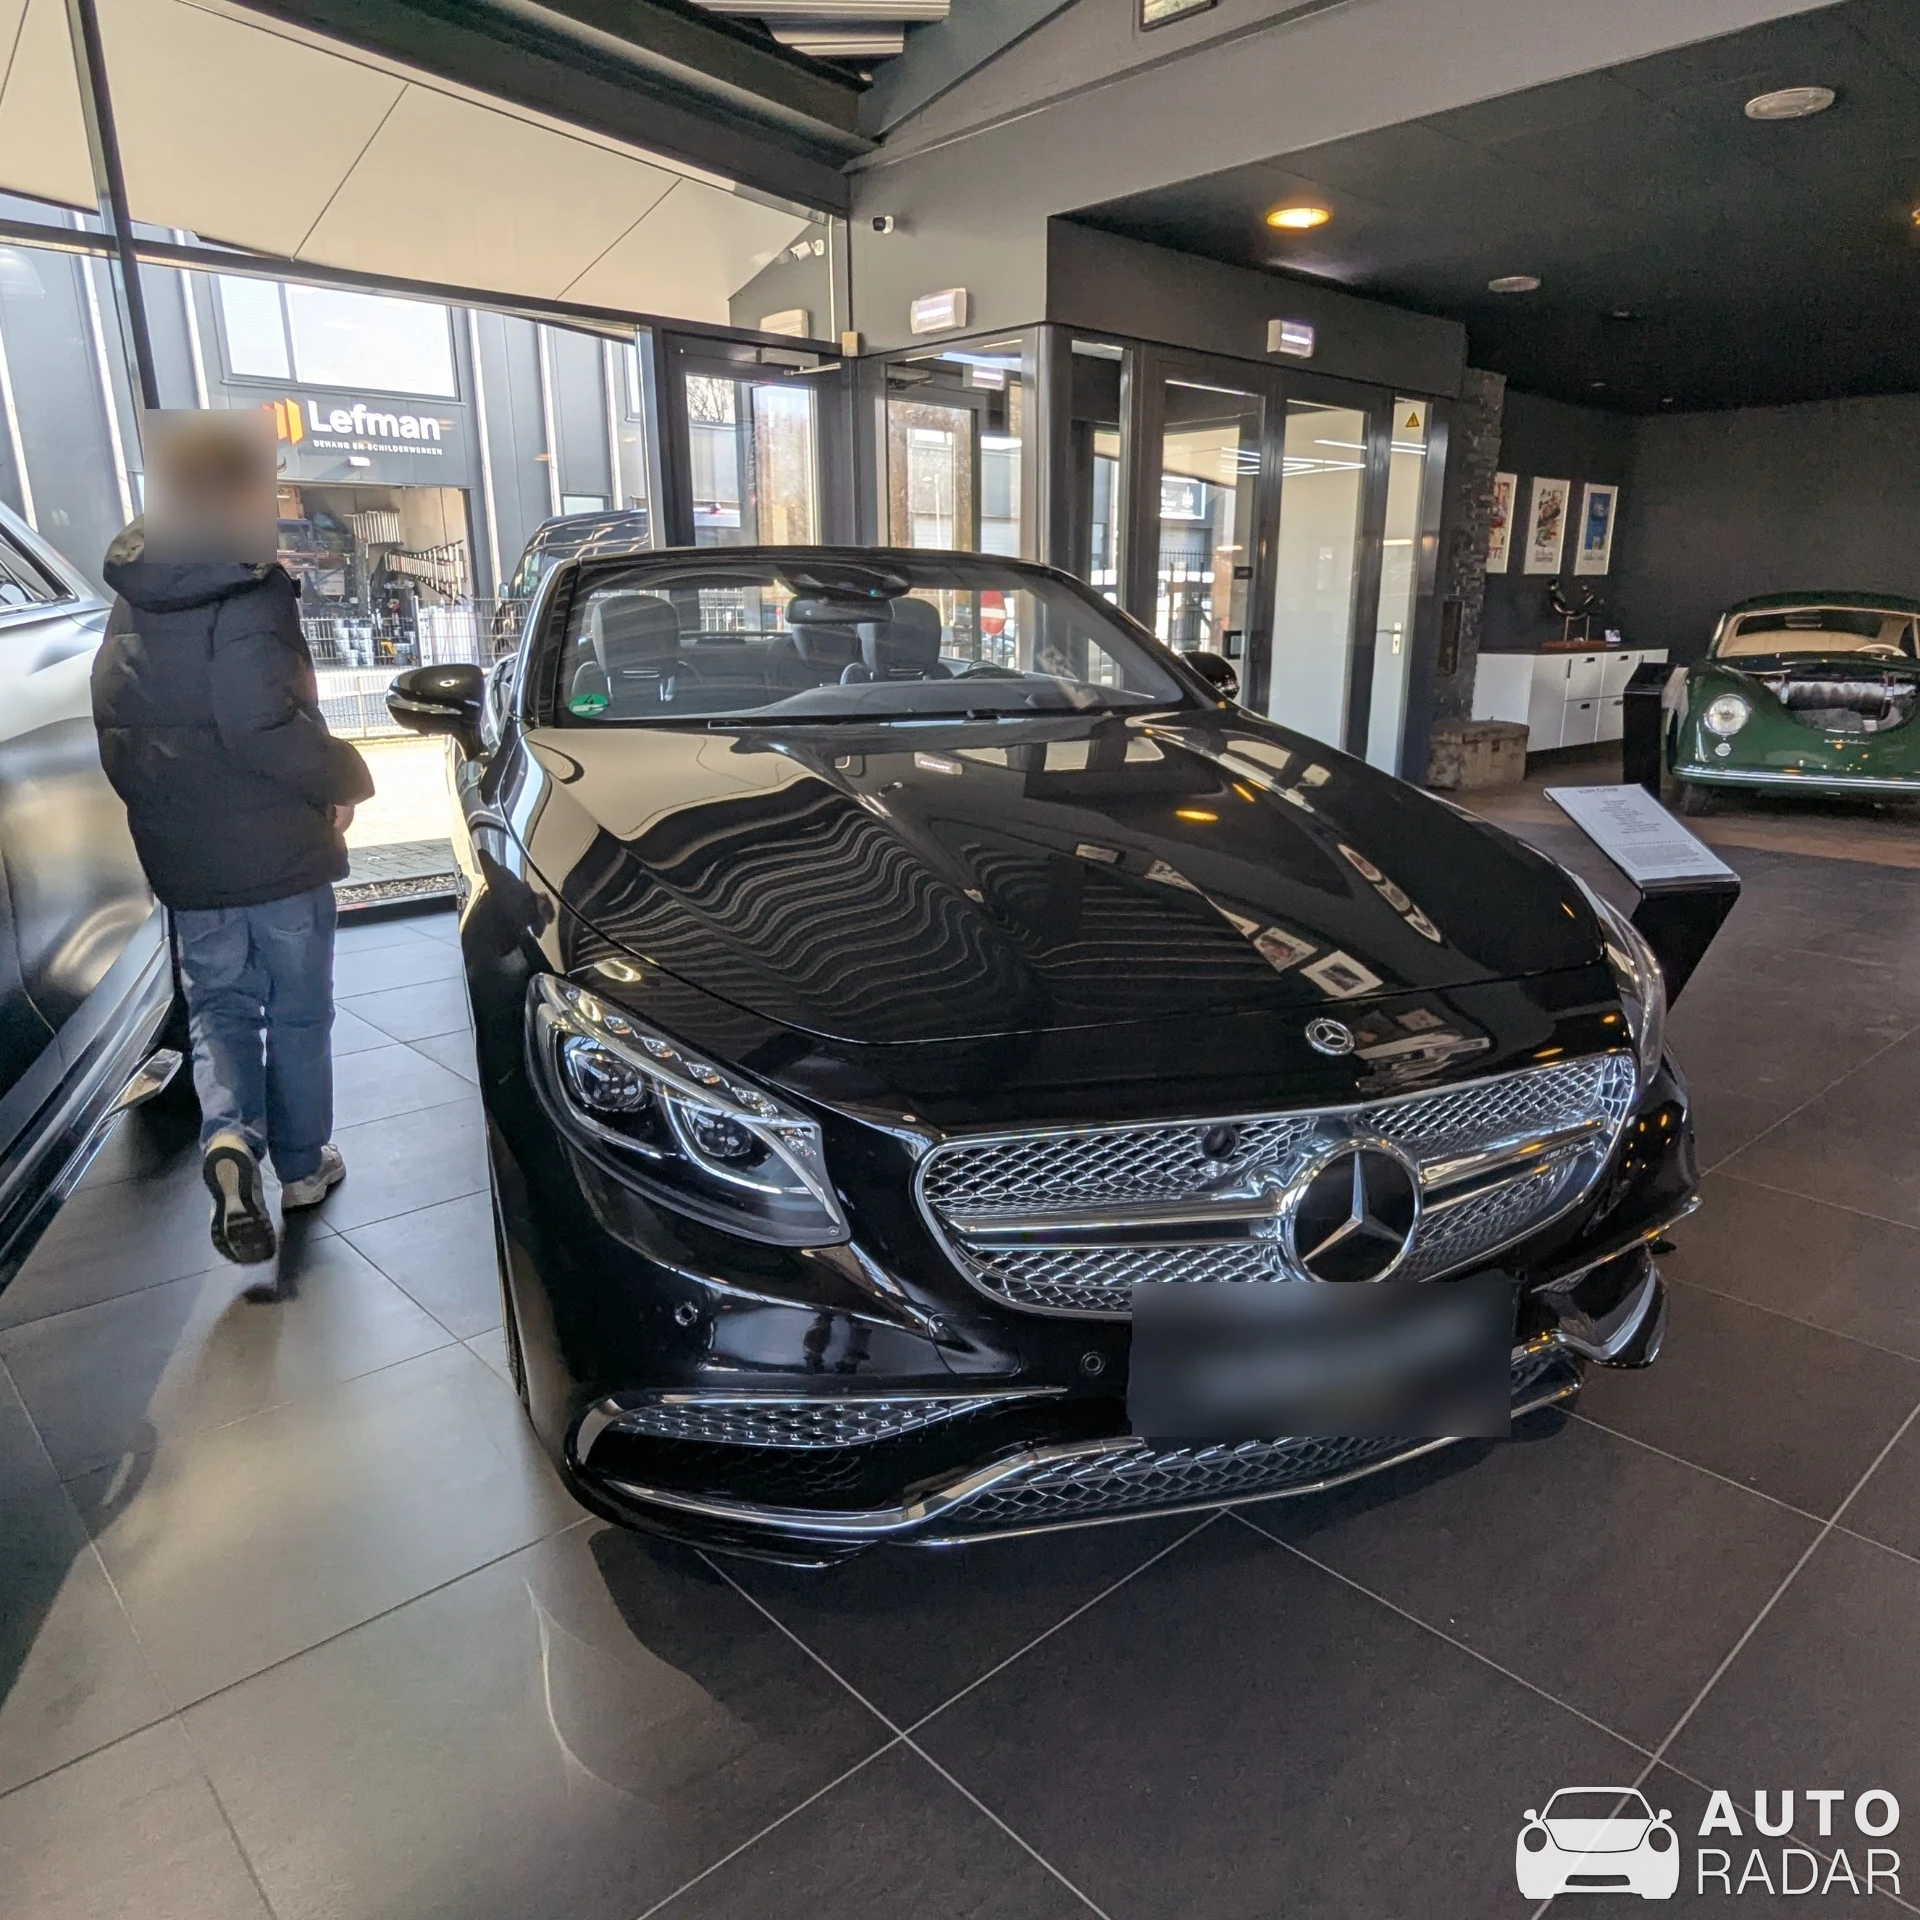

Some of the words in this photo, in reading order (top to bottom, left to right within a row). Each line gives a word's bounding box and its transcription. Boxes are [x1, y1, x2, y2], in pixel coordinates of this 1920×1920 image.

[307, 400, 441, 441] Lefman
[312, 439, 350, 450] BEHANG
[352, 442, 365, 451] EN
[367, 443, 443, 456] SCHILDERWERKEN
